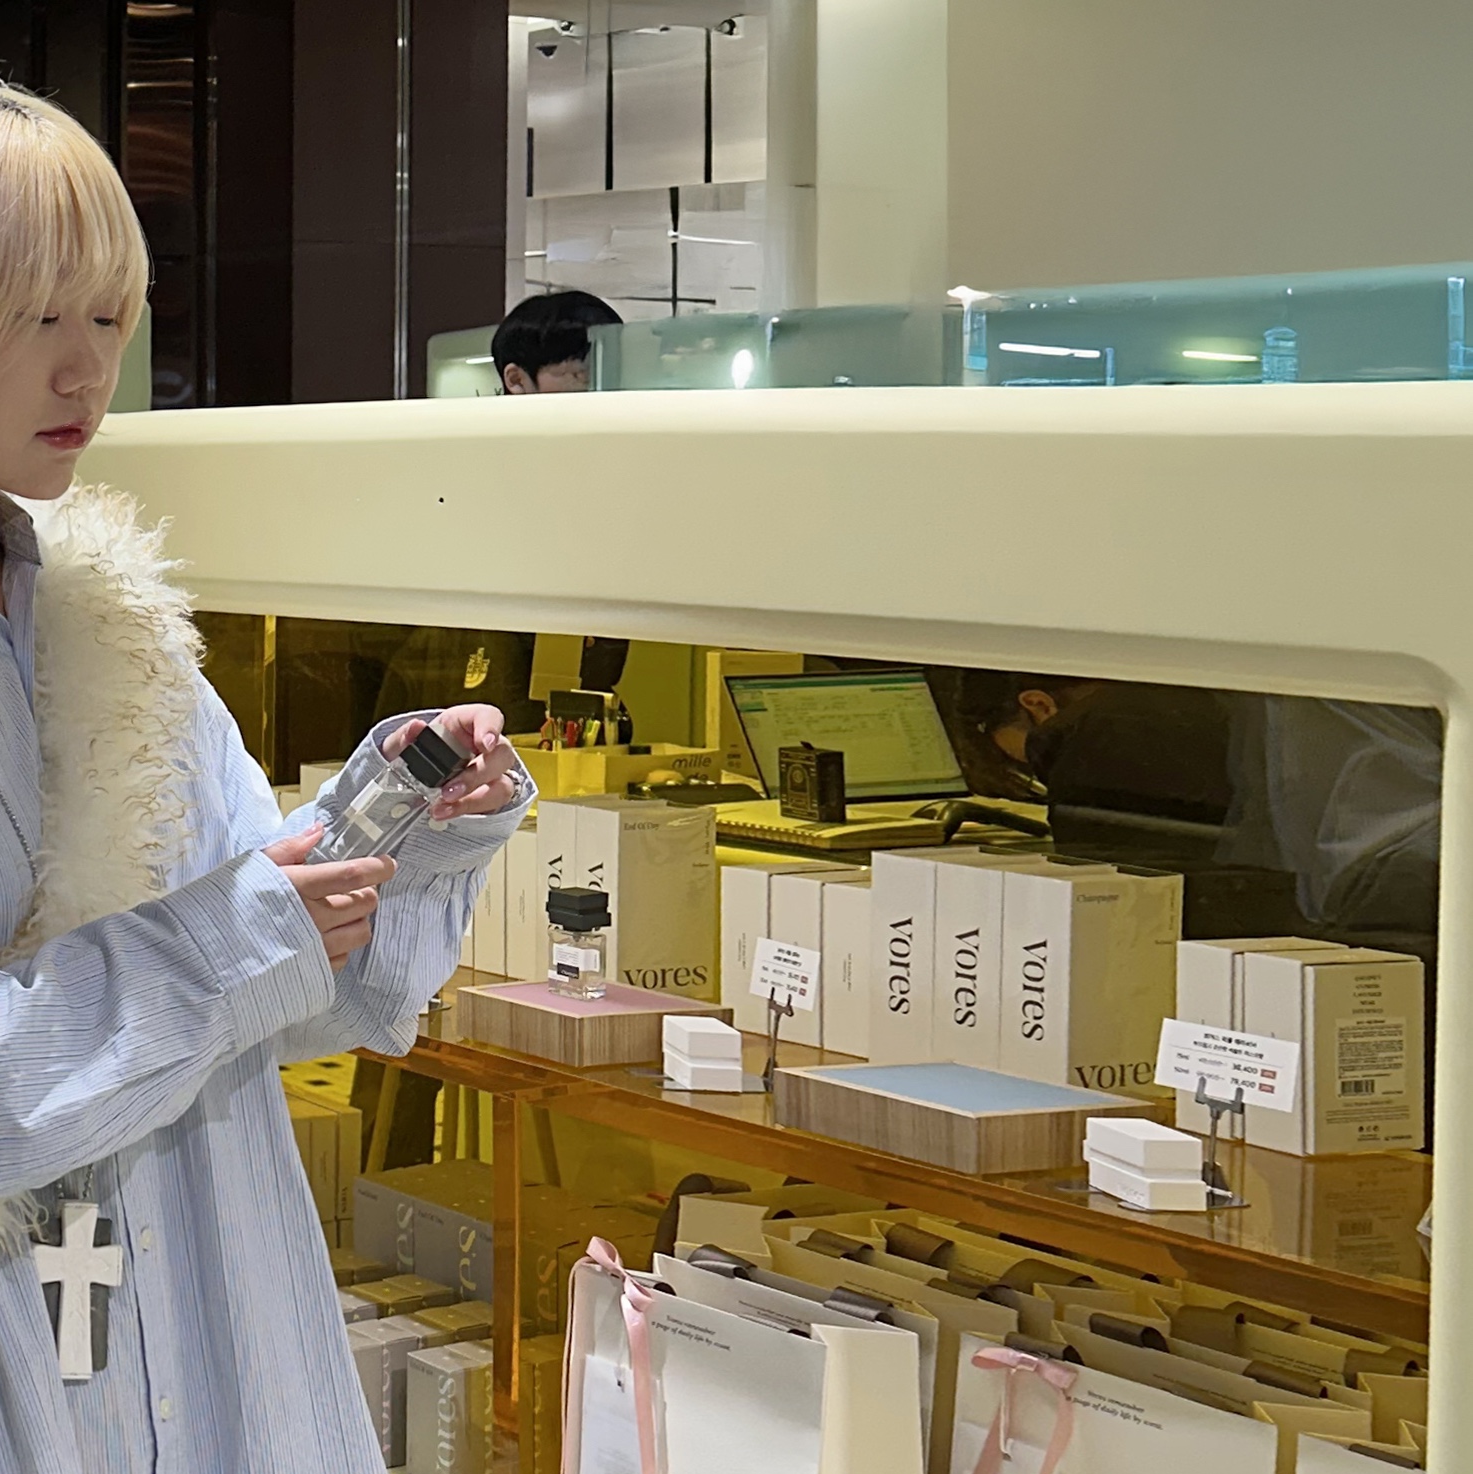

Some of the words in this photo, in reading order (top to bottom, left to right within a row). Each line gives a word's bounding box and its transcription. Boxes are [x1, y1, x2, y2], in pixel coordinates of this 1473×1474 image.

[672, 754, 712, 769] mille
[623, 965, 708, 990] vores
[888, 916, 914, 1015] vores
[953, 927, 981, 1028] vores
[1021, 938, 1048, 1041] vores
[1075, 1061, 1156, 1089] vore
